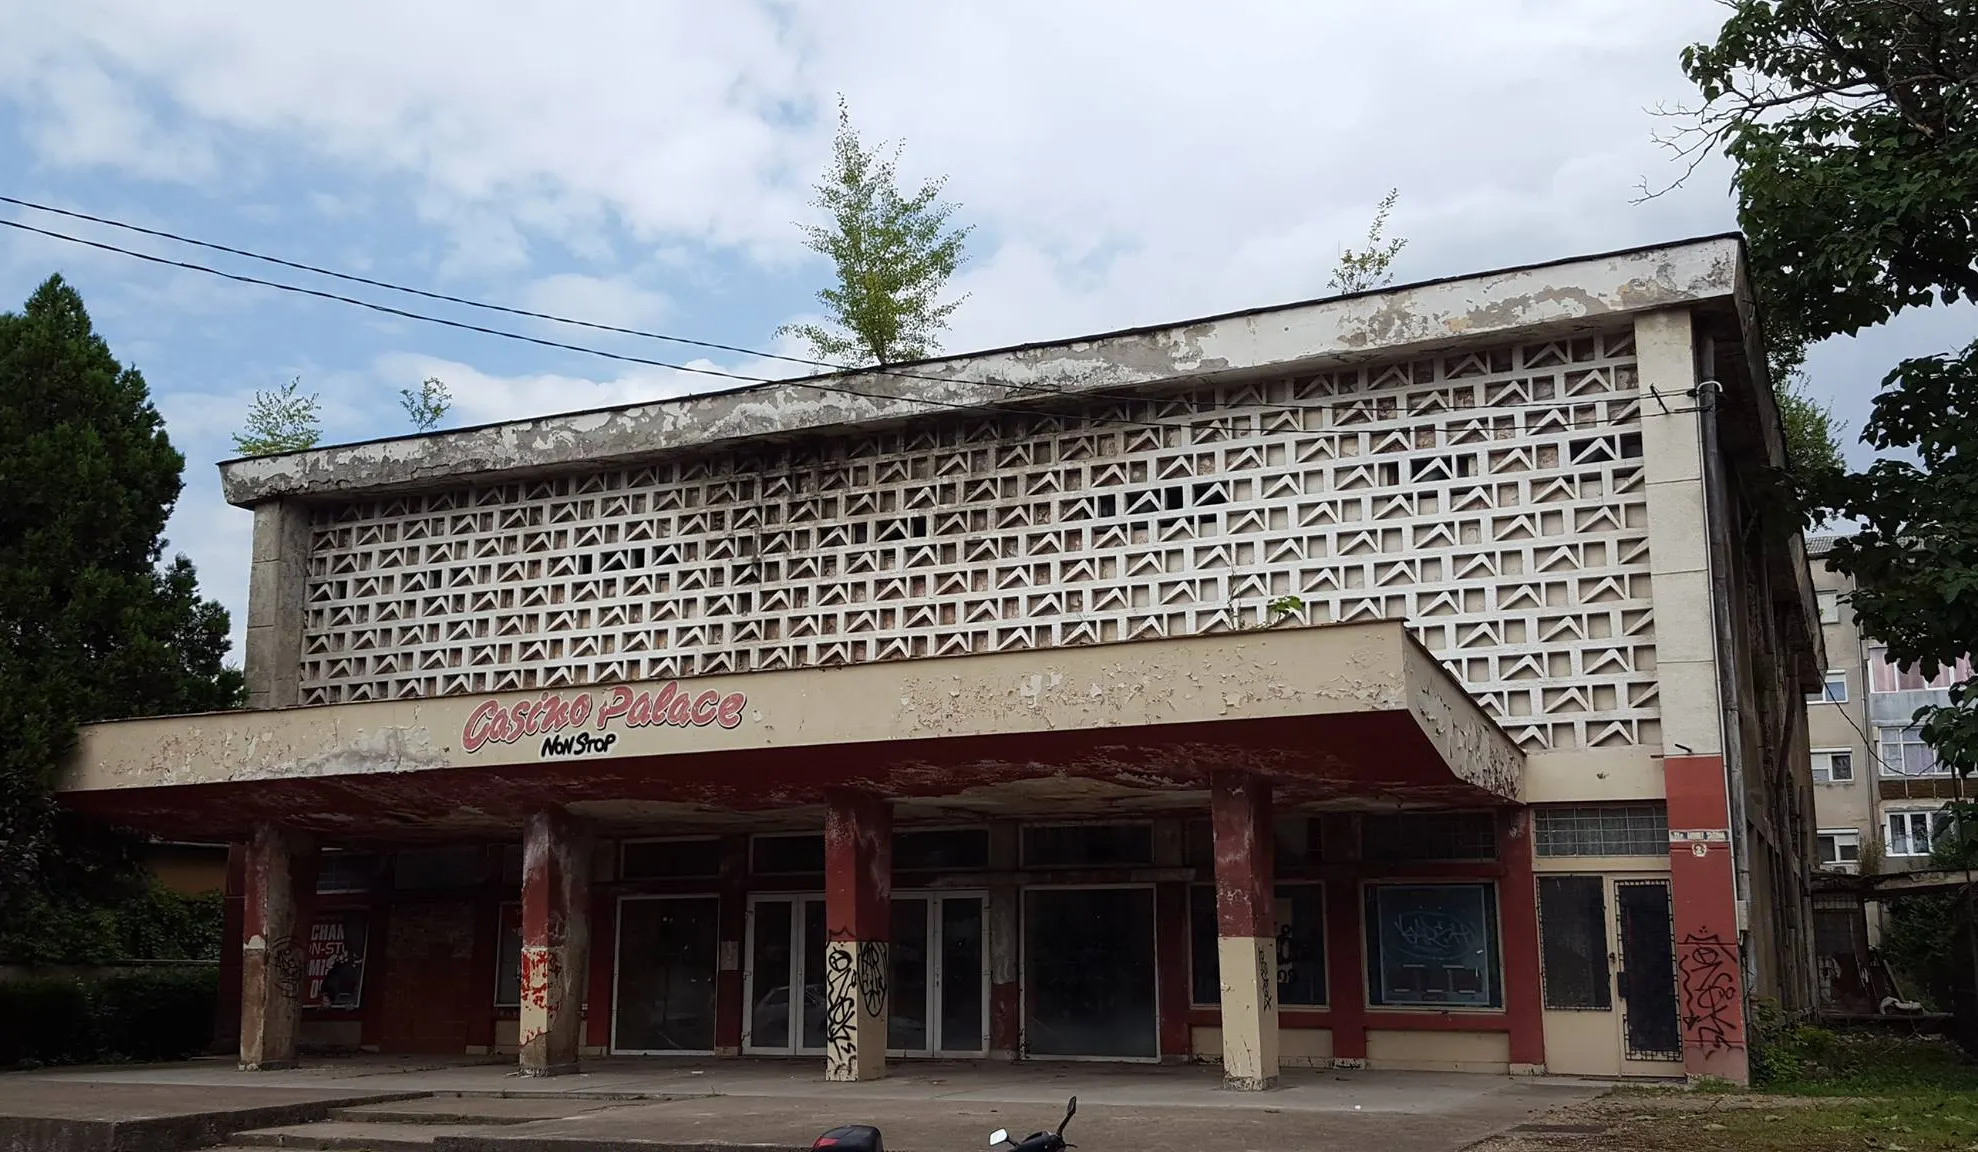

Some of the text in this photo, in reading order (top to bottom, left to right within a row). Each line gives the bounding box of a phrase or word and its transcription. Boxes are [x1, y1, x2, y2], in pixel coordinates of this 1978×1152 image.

[463, 680, 747, 753] Casino Palace
[309, 942, 345, 956] N-ST
